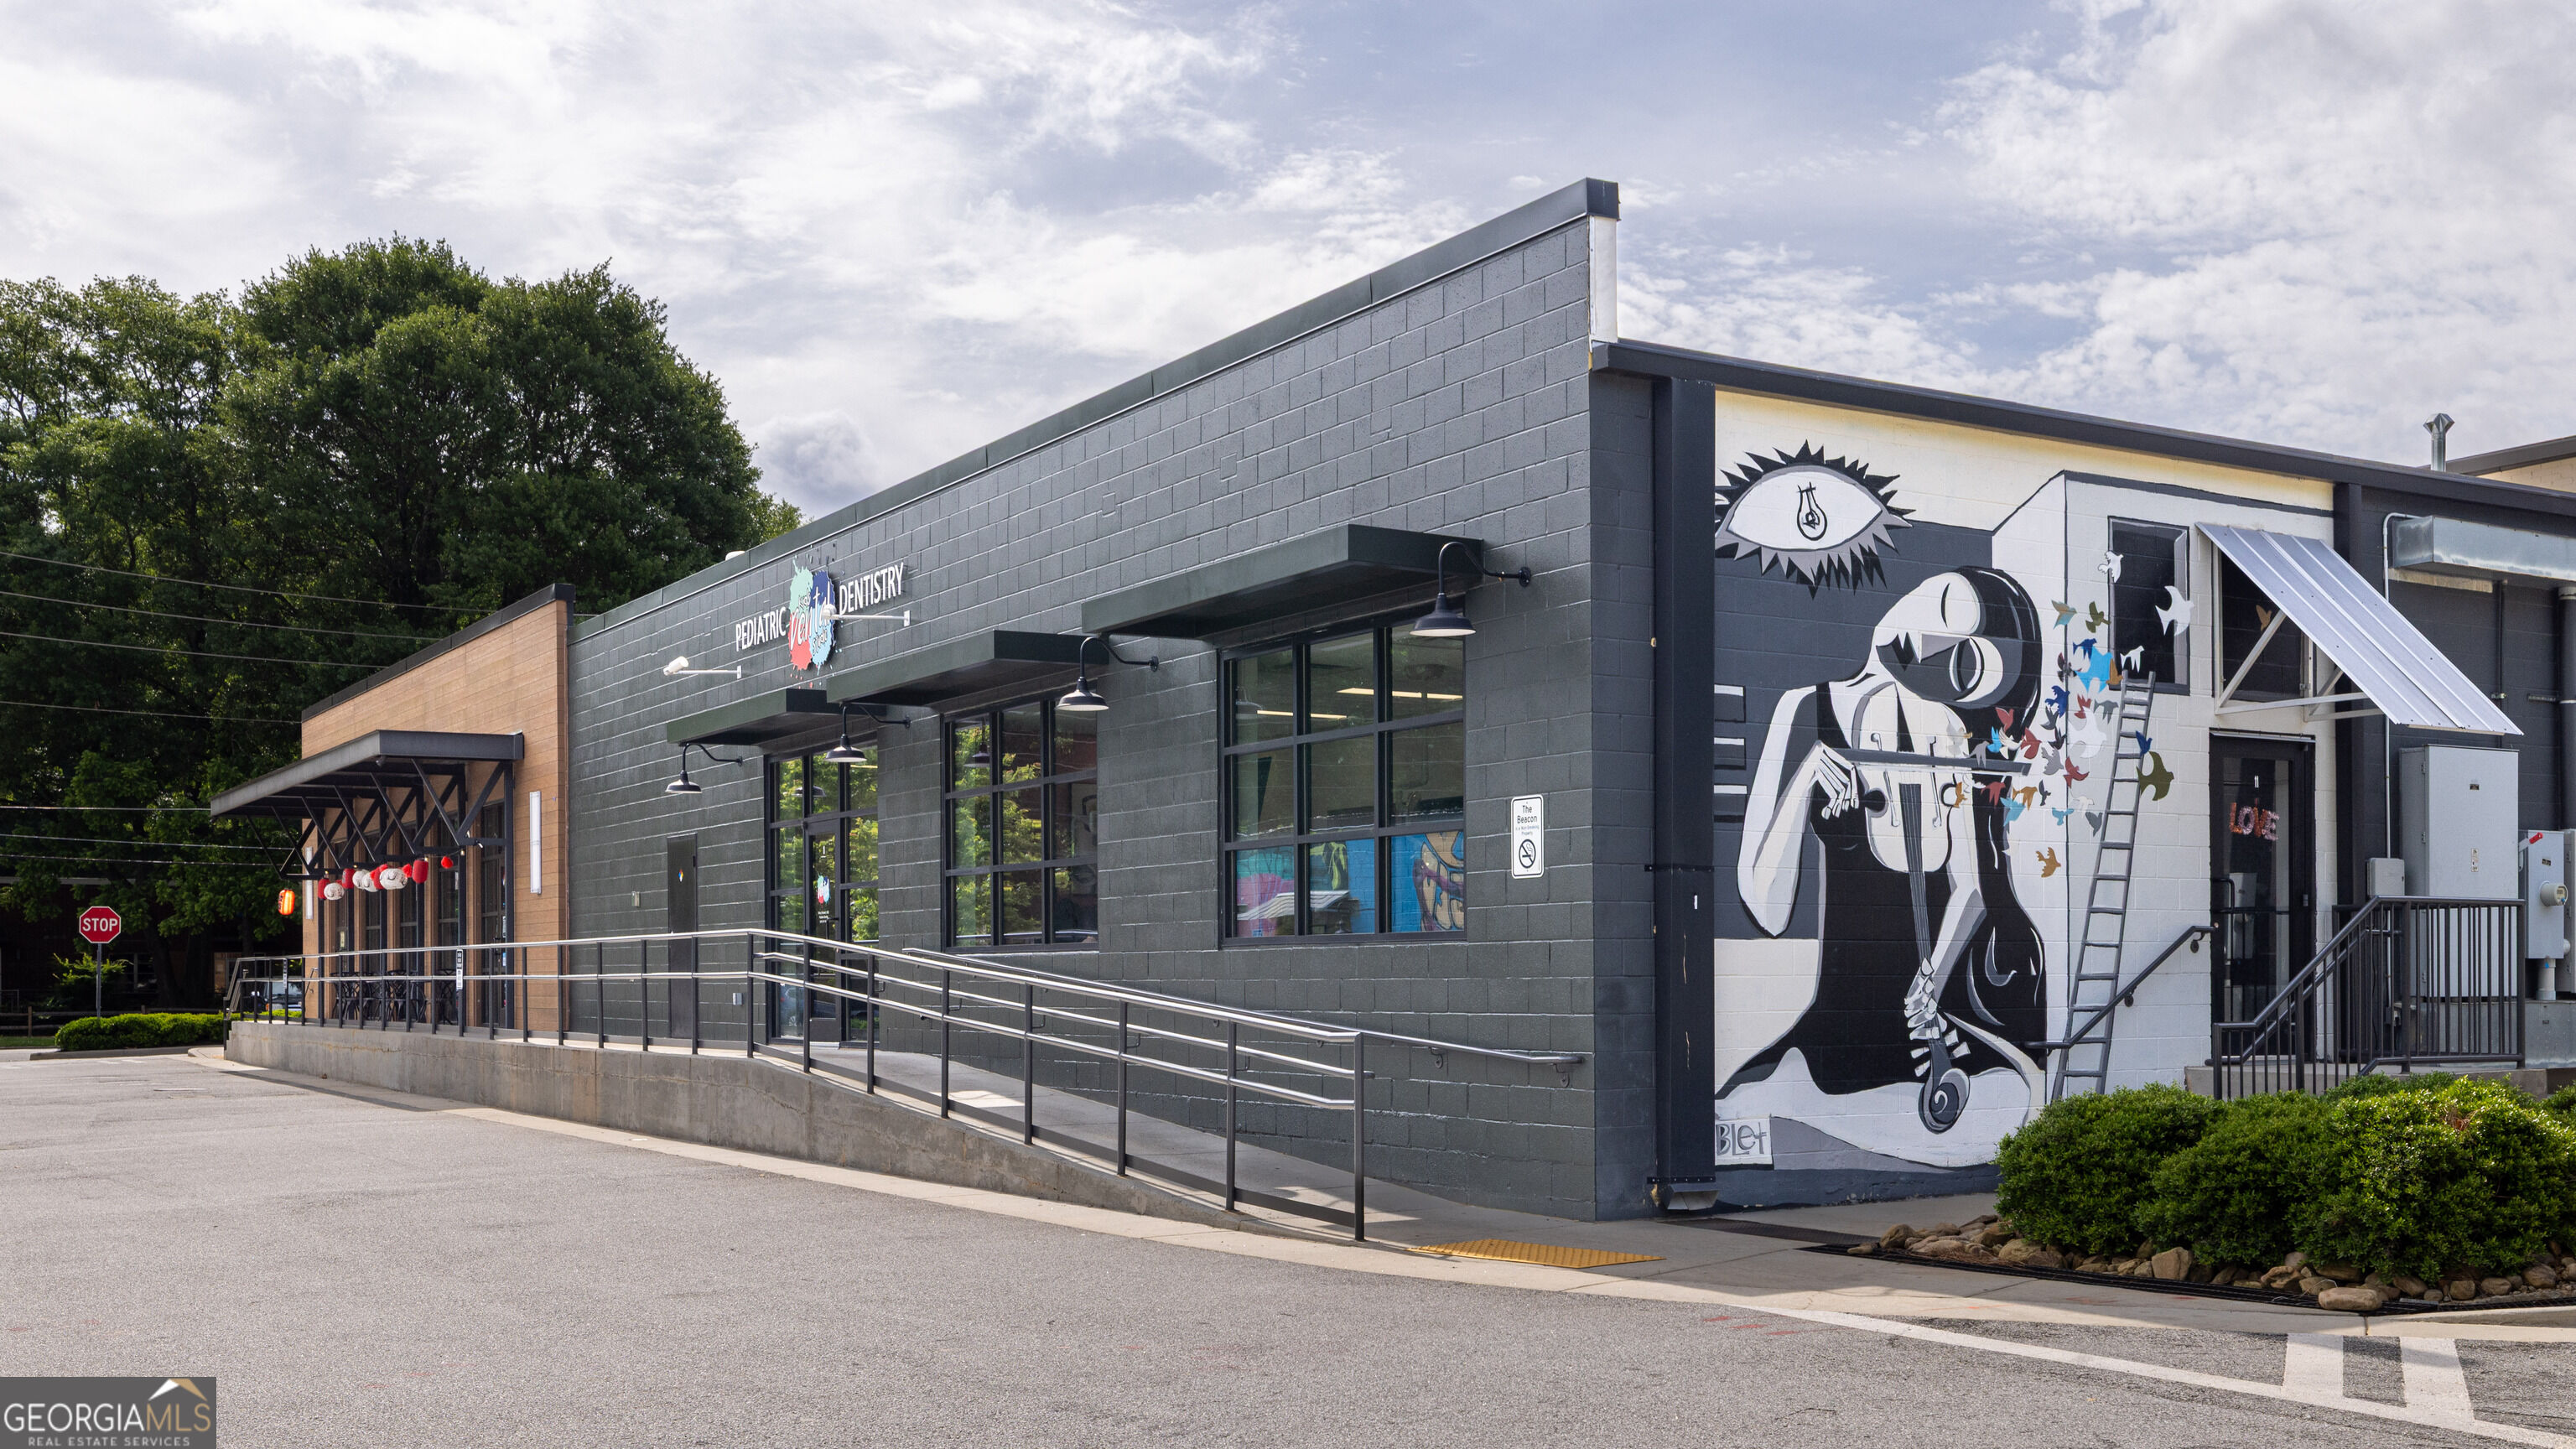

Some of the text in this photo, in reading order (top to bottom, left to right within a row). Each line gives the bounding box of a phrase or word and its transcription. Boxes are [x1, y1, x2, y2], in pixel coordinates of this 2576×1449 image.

[735, 562, 904, 652] PEDIATRIC DENTISTRY
[1522, 805, 1533, 813] The
[1517, 815, 1538, 823] Beacon
[2229, 802, 2280, 841] LOVE
[82, 917, 118, 932] STOP
